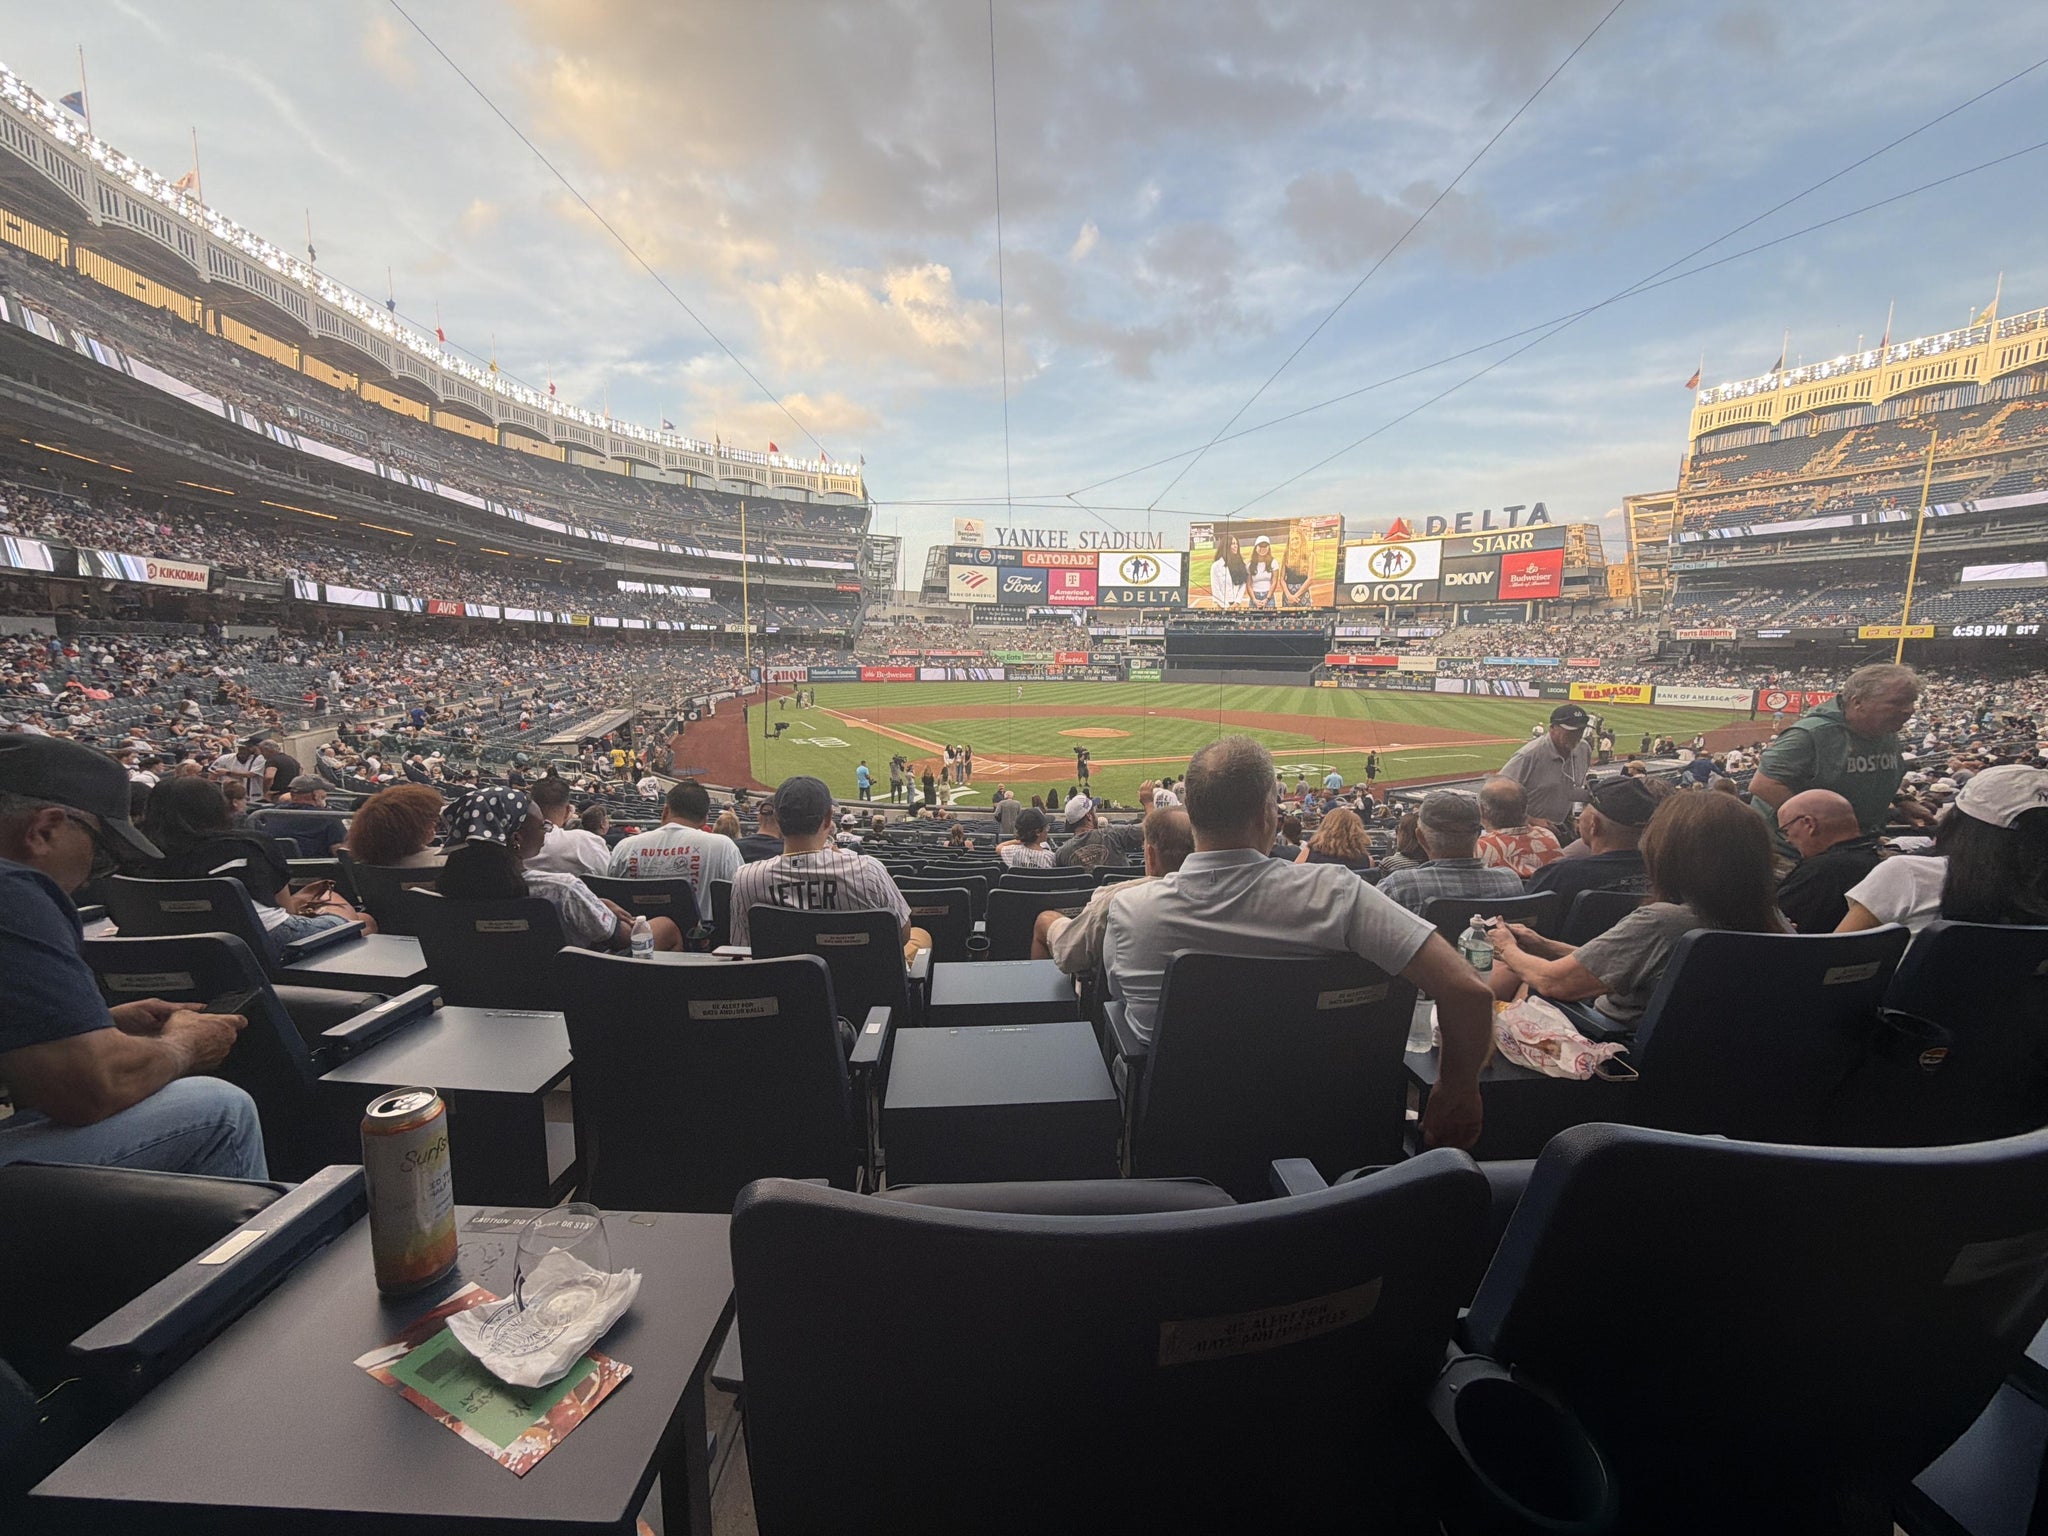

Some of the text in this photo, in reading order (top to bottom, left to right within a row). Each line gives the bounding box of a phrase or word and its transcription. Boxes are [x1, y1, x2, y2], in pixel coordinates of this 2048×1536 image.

[1426, 502, 1552, 536] DELTA
[995, 528, 1163, 550] YANKEE STADIUM
[1472, 532, 1534, 554] STARR
[1027, 554, 1094, 566] GATORADE
[160, 567, 206, 582] KIKKOMAN
[1445, 571, 1494, 586] DKNY
[1510, 573, 1552, 582] Budweiser
[1003, 575, 1042, 594] Ford
[1374, 583, 1423, 601] razr
[1123, 590, 1181, 602] DELTA
[437, 601, 456, 614] AVIS
[1952, 625, 2040, 636] 6:58 PM 81°F
[762, 670, 806, 680] Canon
[1847, 752, 1898, 773] BOSTON
[641, 845, 691, 857] RUTGERS
